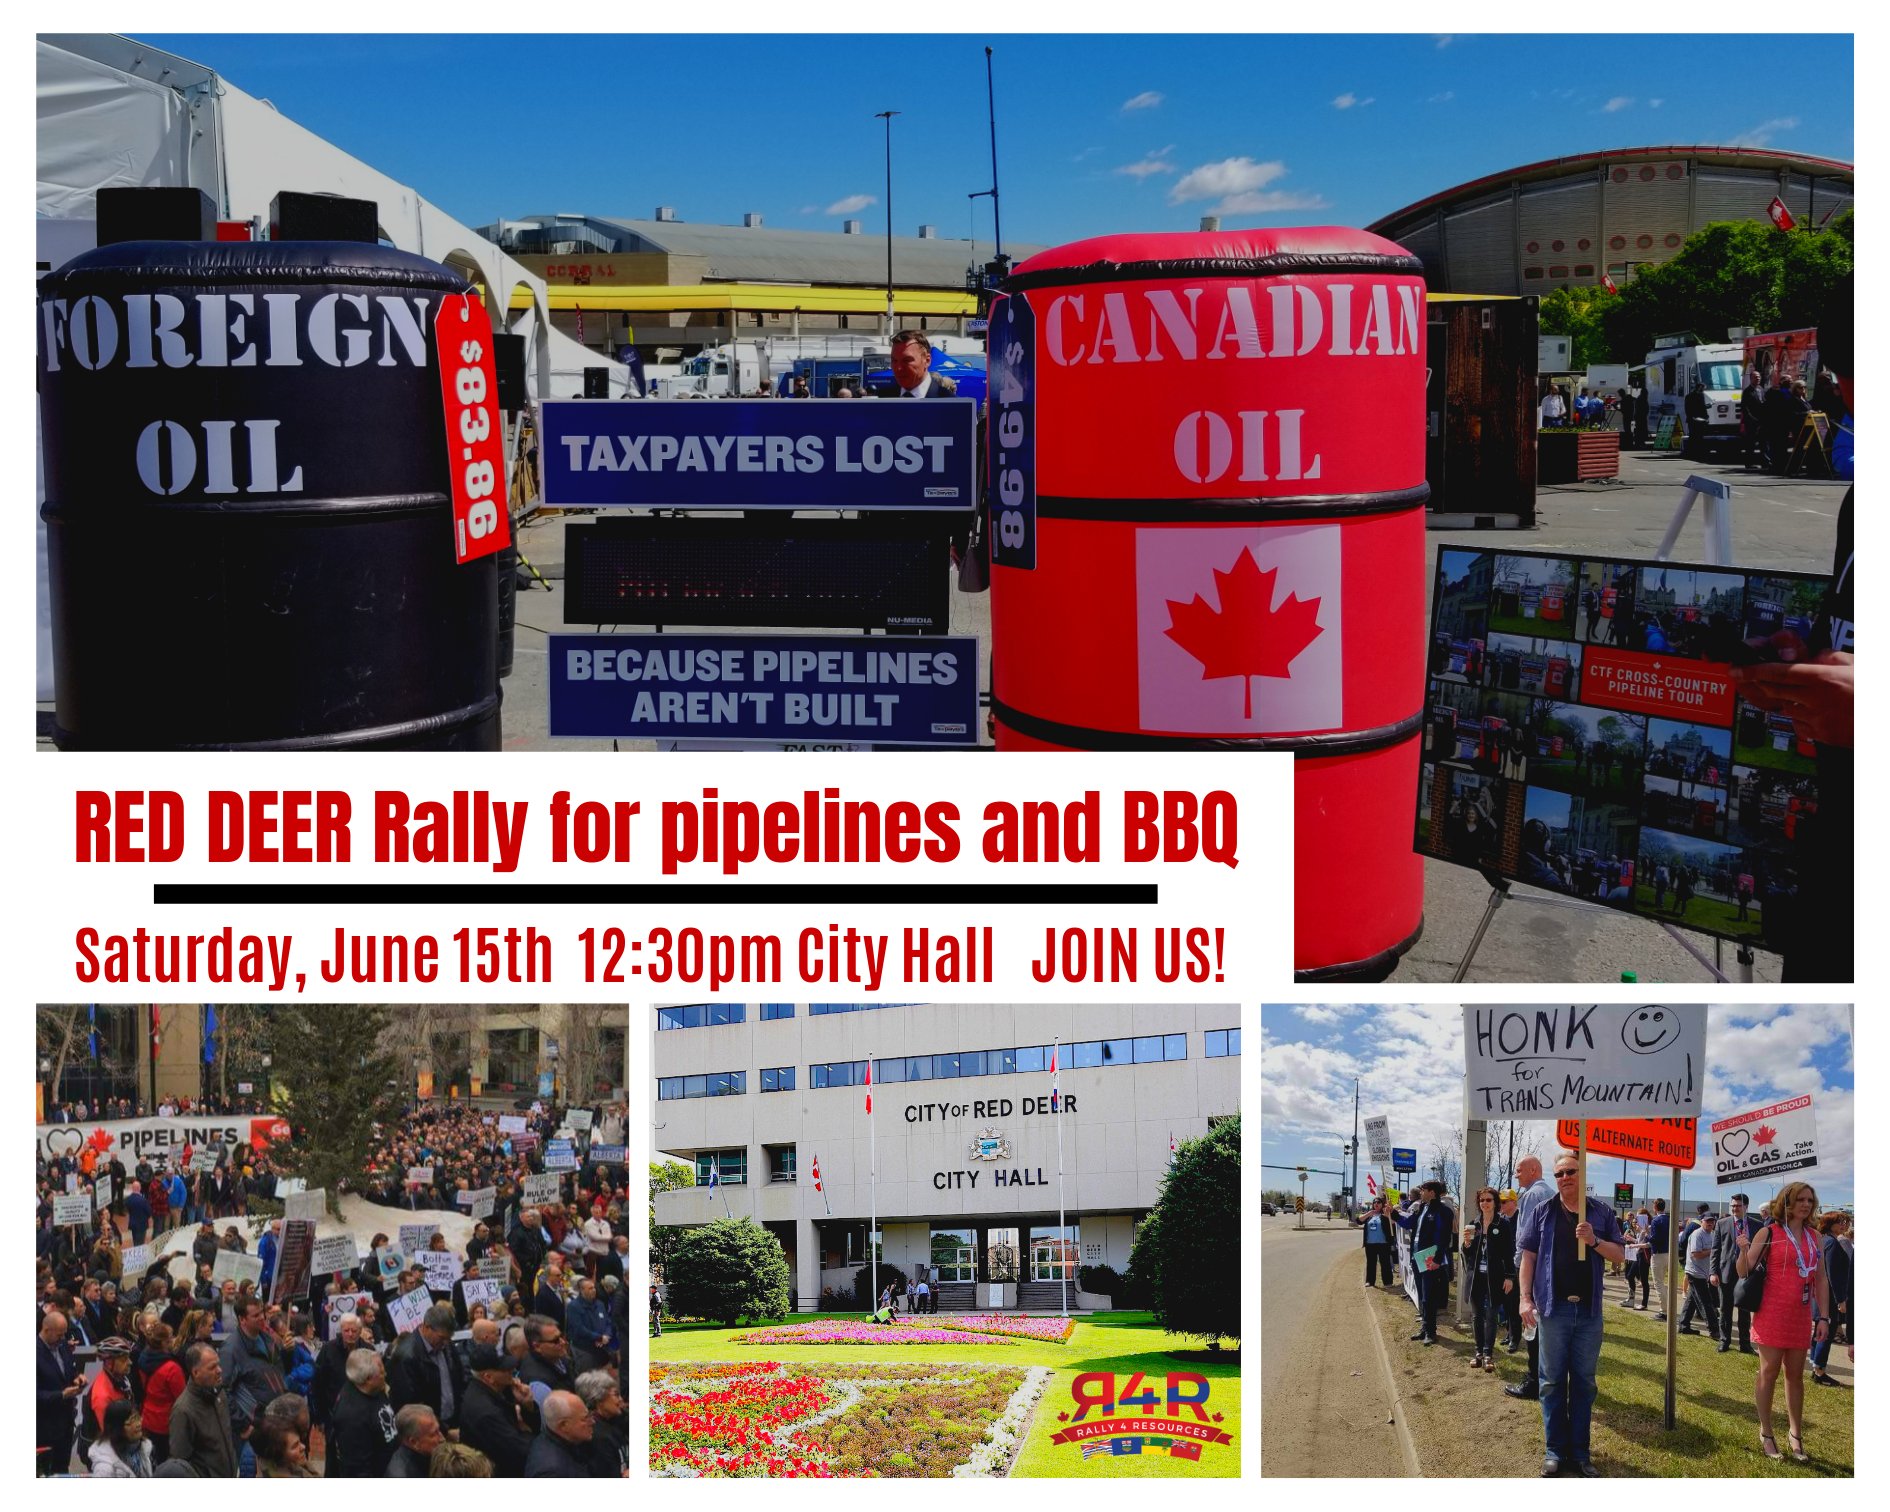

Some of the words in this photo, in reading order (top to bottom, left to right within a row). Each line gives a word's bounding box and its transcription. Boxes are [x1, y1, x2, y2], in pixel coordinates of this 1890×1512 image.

[41, 292, 430, 372] FOREIGN
[1045, 284, 1421, 367] CANADIAN
[135, 418, 304, 496] OIL
[456, 340, 498, 540] $83.86
[561, 435, 824, 474] TAXPAYERS
[835, 436, 954, 474] LOST
[998, 341, 1025, 549] $49.98
[1173, 409, 1321, 484] OIL
[887, 617, 933, 625] NU-MEDIA
[566, 649, 745, 683] BECAUSE
[753, 651, 958, 686] PIPELINES
[1590, 665, 1613, 678] CTF
[1617, 669, 1727, 695] CROSS-COUNTRY
[631, 691, 774, 724] AREN'T
[784, 693, 900, 727] BUILT
[1608, 680, 1664, 699] PIPELINE
[1669, 689, 1704, 706] TOUR
[1476, 1005, 1598, 1058] HONK
[1476, 1083, 1554, 1113] TRANS
[1561, 1053, 1692, 1105] MOUNTAIN!
[1511, 1061, 1545, 1081] for
[904, 1103, 950, 1123] CITY
[974, 1099, 1013, 1119] RED
[1022, 1094, 1078, 1116] DEER
[1713, 1123, 1726, 1131] WE
[1728, 1112, 1761, 1127] SHOULD
[1763, 1108, 1775, 1117] BE
[1776, 1097, 1809, 1113] PROUD
[1565, 1121, 1587, 1138] US
[1592, 1127, 1654, 1152] ALTERNATE
[1658, 1141, 1692, 1159] ROUTE
[1715, 1141, 1720, 1156] I
[1785, 1147, 1814, 1159] Action.
[1794, 1140, 1813, 1149] Take
[933, 1171, 980, 1190] CITY
[994, 1167, 1049, 1188] HALL
[1717, 1159, 1740, 1173] OIL
[1742, 1160, 1748, 1168] &
[1749, 1149, 1780, 1166] GAS
[527, 1190, 545, 1198] RULE
